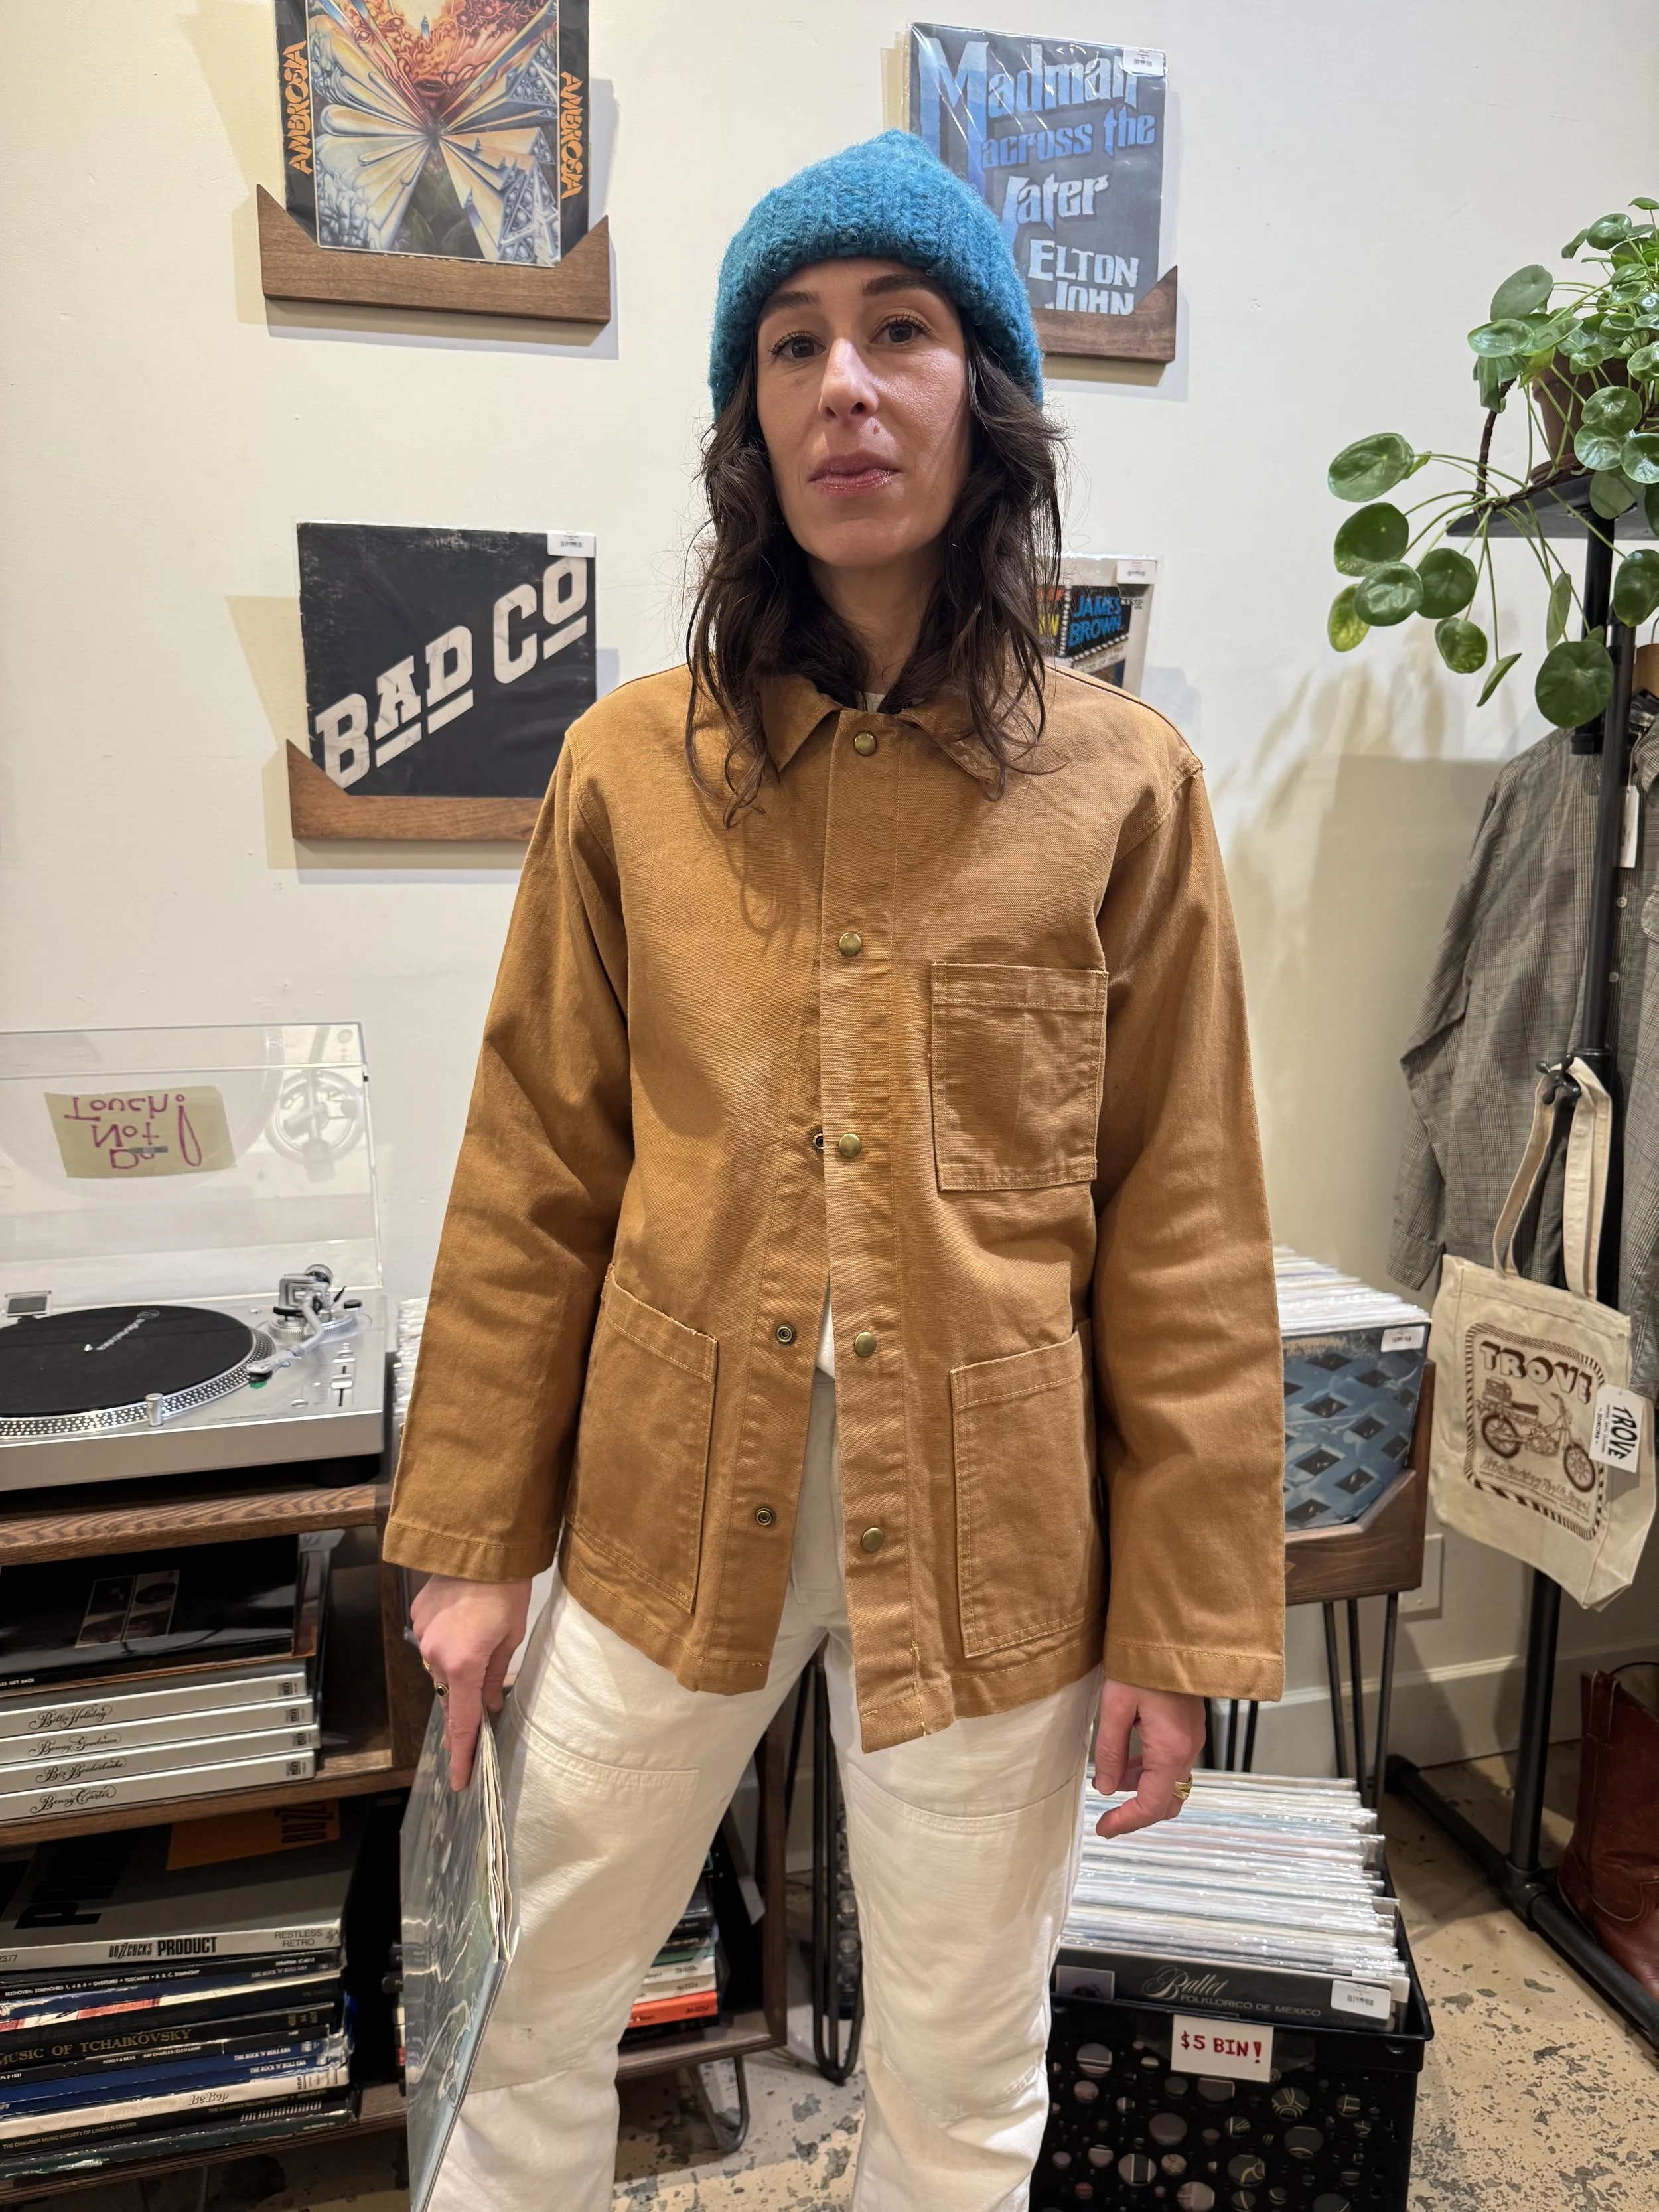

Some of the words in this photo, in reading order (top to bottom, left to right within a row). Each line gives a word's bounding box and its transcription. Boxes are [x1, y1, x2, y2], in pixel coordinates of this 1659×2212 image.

[283, 40, 313, 175] AMBROSIA
[560, 71, 583, 199] AMBROSIA
[981, 122, 1093, 168] across
[1103, 106, 1156, 156] the
[1029, 239, 1139, 287] ELTON
[1045, 281, 1133, 315] JOHN
[1074, 595, 1122, 617] JAMES
[1068, 615, 1122, 648] BROWN
[315, 625, 473, 789] BAD
[1479, 1340, 1593, 1404] TROVE
[1607, 1406, 1638, 1459] TROVE
[60, 1704, 113, 1726] Holiday
[29, 1738, 71, 1757] Benny
[69, 1732, 121, 1751] Goodman
[35, 1765, 66, 1783] Bix
[31, 1793, 76, 1814] Benny
[71, 1785, 116, 1804] Carter
[157, 1937, 217, 1956] PRODUCT
[275, 1929, 323, 1939] RESTLESS
[283, 1938, 315, 1947] RETRO
[1141, 1964, 1229, 2000] Ballet
[1181, 1994, 1253, 2010] FOLKLORICO
[1274, 2006, 1321, 2017] MEXICO
[52, 2044, 73, 2056] OF
[1181, 2030, 1205, 2050] $5
[188, 2091, 229, 2105] BeBop
[15, 2138, 41, 2147] CHAMBER
